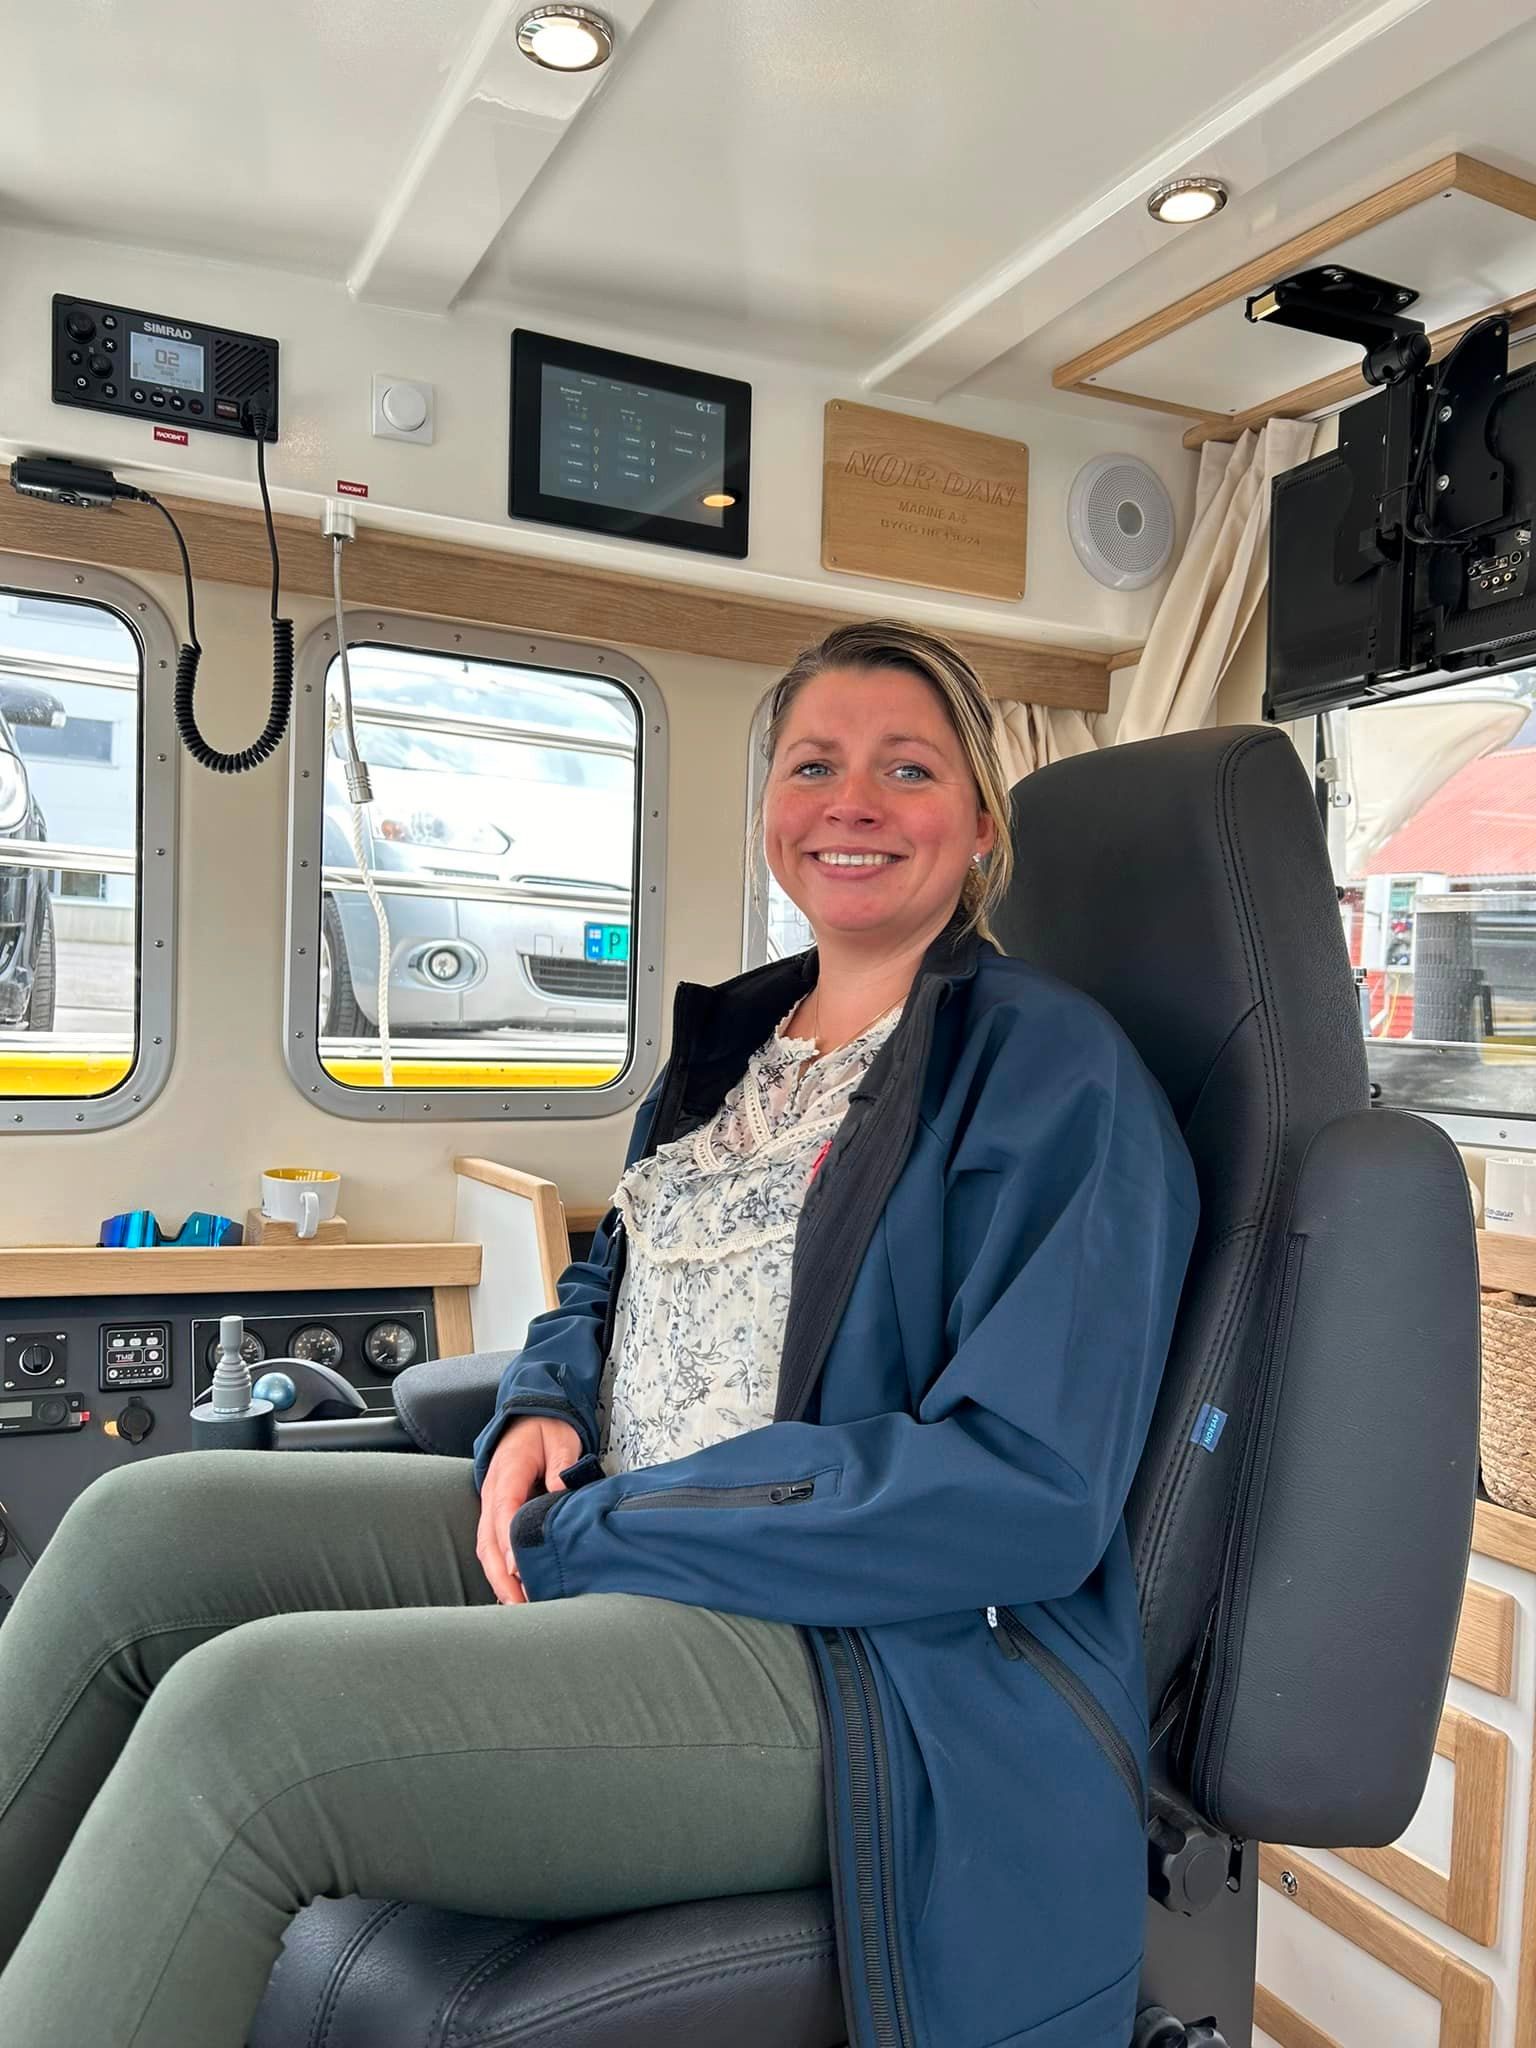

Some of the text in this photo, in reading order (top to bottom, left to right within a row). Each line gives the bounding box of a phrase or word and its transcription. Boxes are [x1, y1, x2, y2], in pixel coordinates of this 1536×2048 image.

[143, 321, 192, 340] SIMRAD
[155, 349, 180, 367] 02
[942, 472, 1017, 506] DAN
[898, 501, 945, 520] MARINE
